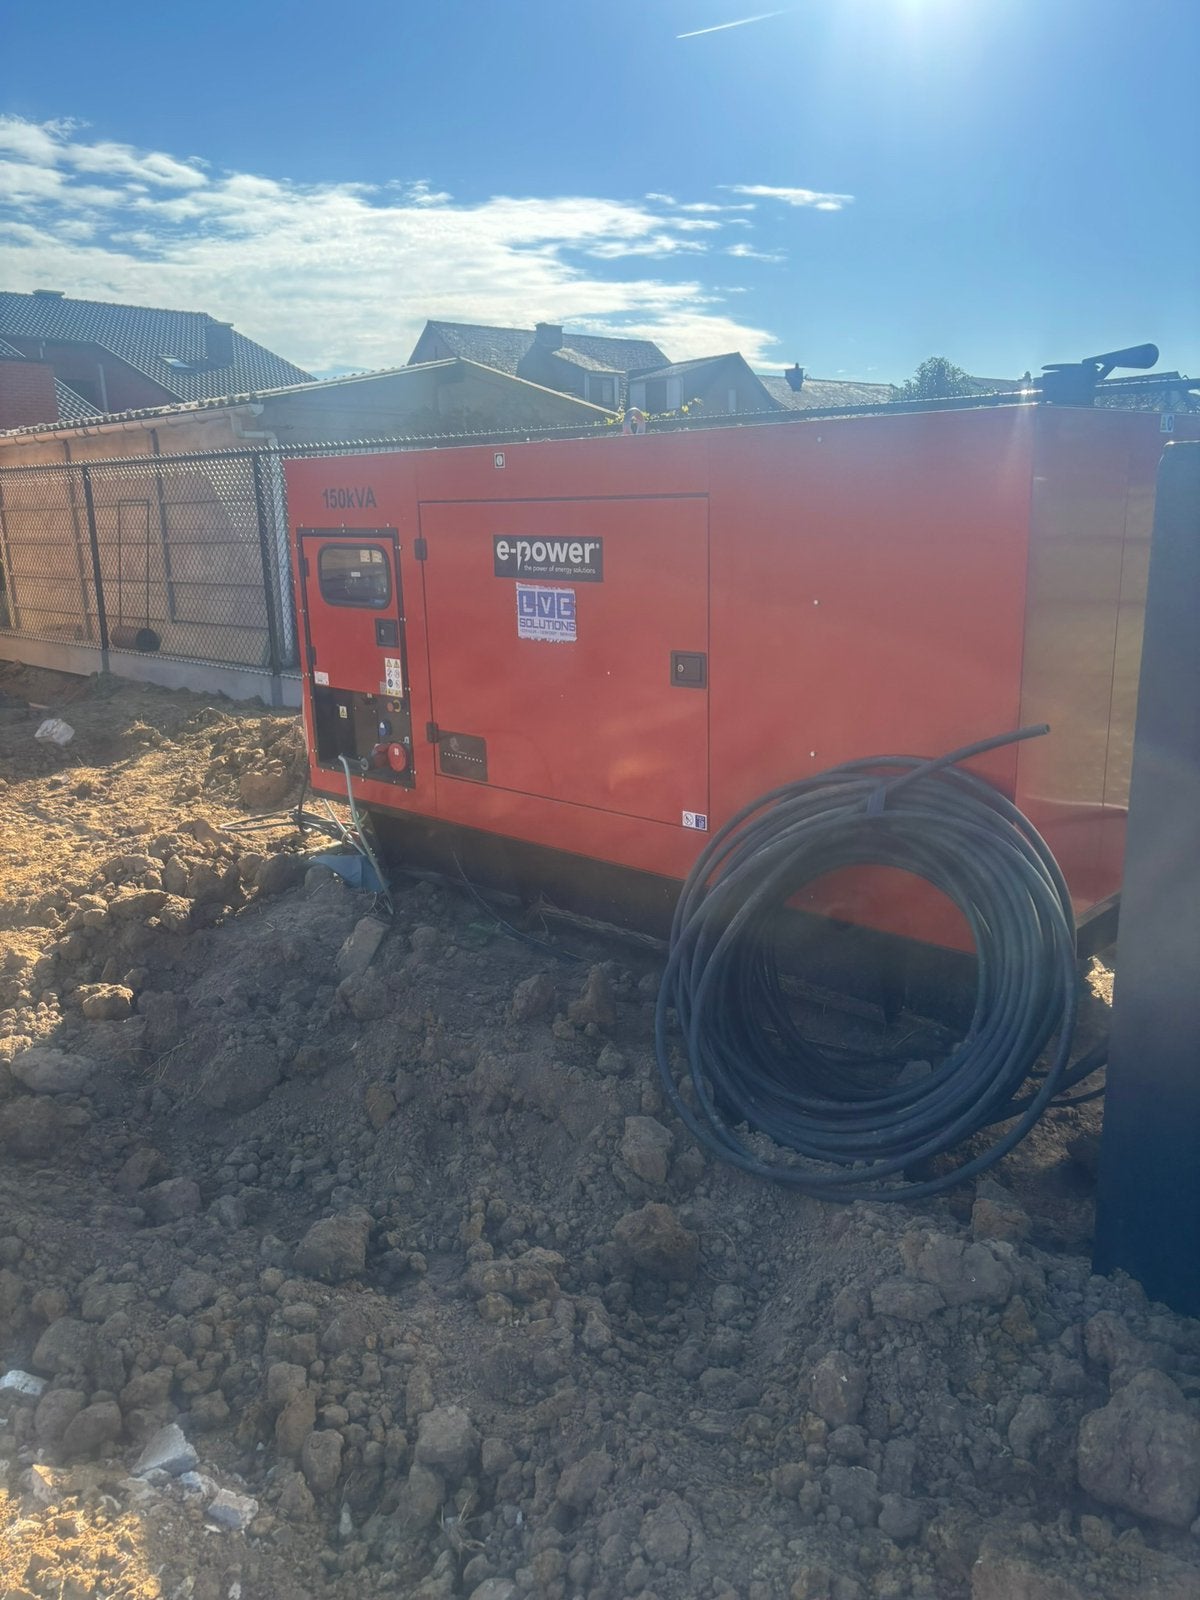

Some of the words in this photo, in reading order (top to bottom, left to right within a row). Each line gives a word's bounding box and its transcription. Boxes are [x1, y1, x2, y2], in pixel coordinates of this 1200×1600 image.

[322, 487, 377, 509] 150kVA
[496, 540, 596, 571] e-power
[533, 565, 548, 573] power
[555, 566, 572, 575] energy
[522, 595, 572, 616] LVC
[519, 618, 576, 632] SOLUTIONS
